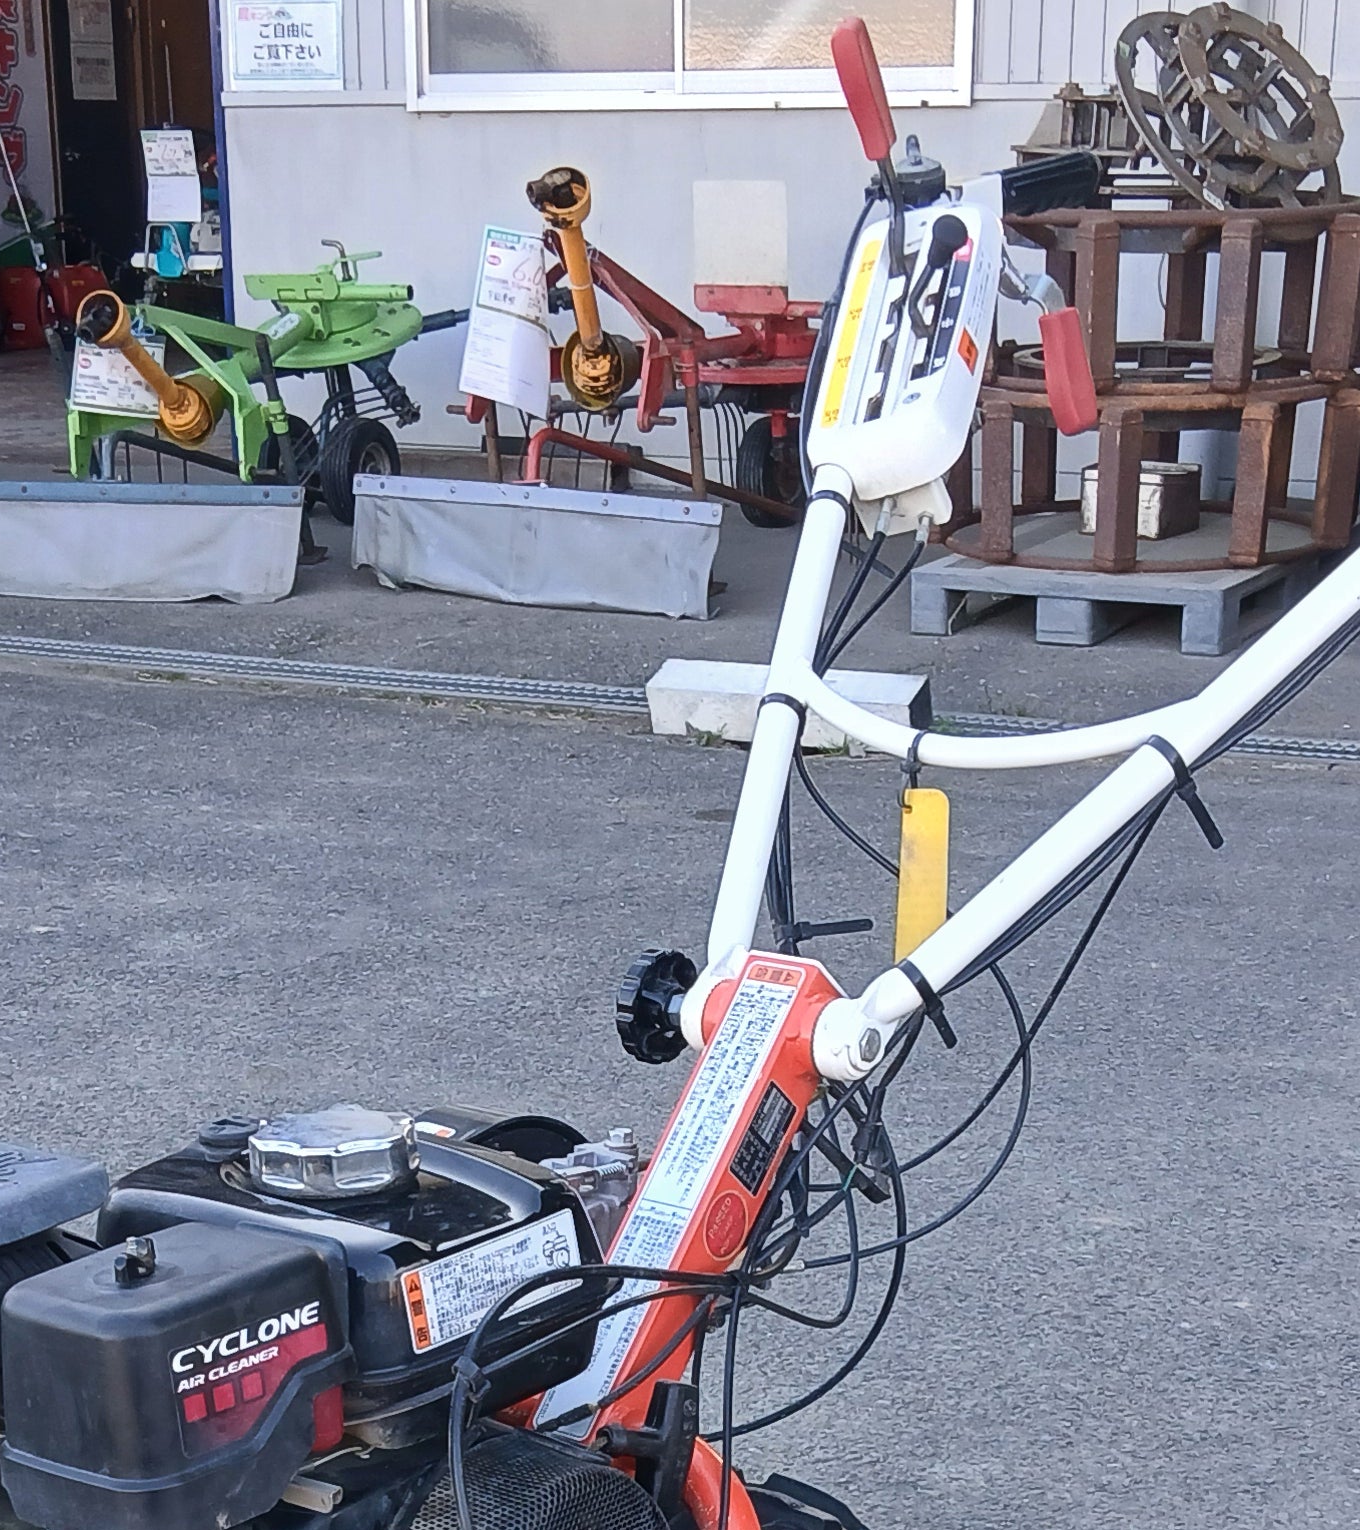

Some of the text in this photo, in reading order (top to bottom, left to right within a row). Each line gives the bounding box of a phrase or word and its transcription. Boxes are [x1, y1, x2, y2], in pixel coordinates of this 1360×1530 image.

[259, 22, 314, 39] ご自由に
[253, 43, 322, 60] ご覧下さい
[171, 1300, 320, 1373] CYCLONE
[177, 1346, 279, 1393] AIR CLEANER
